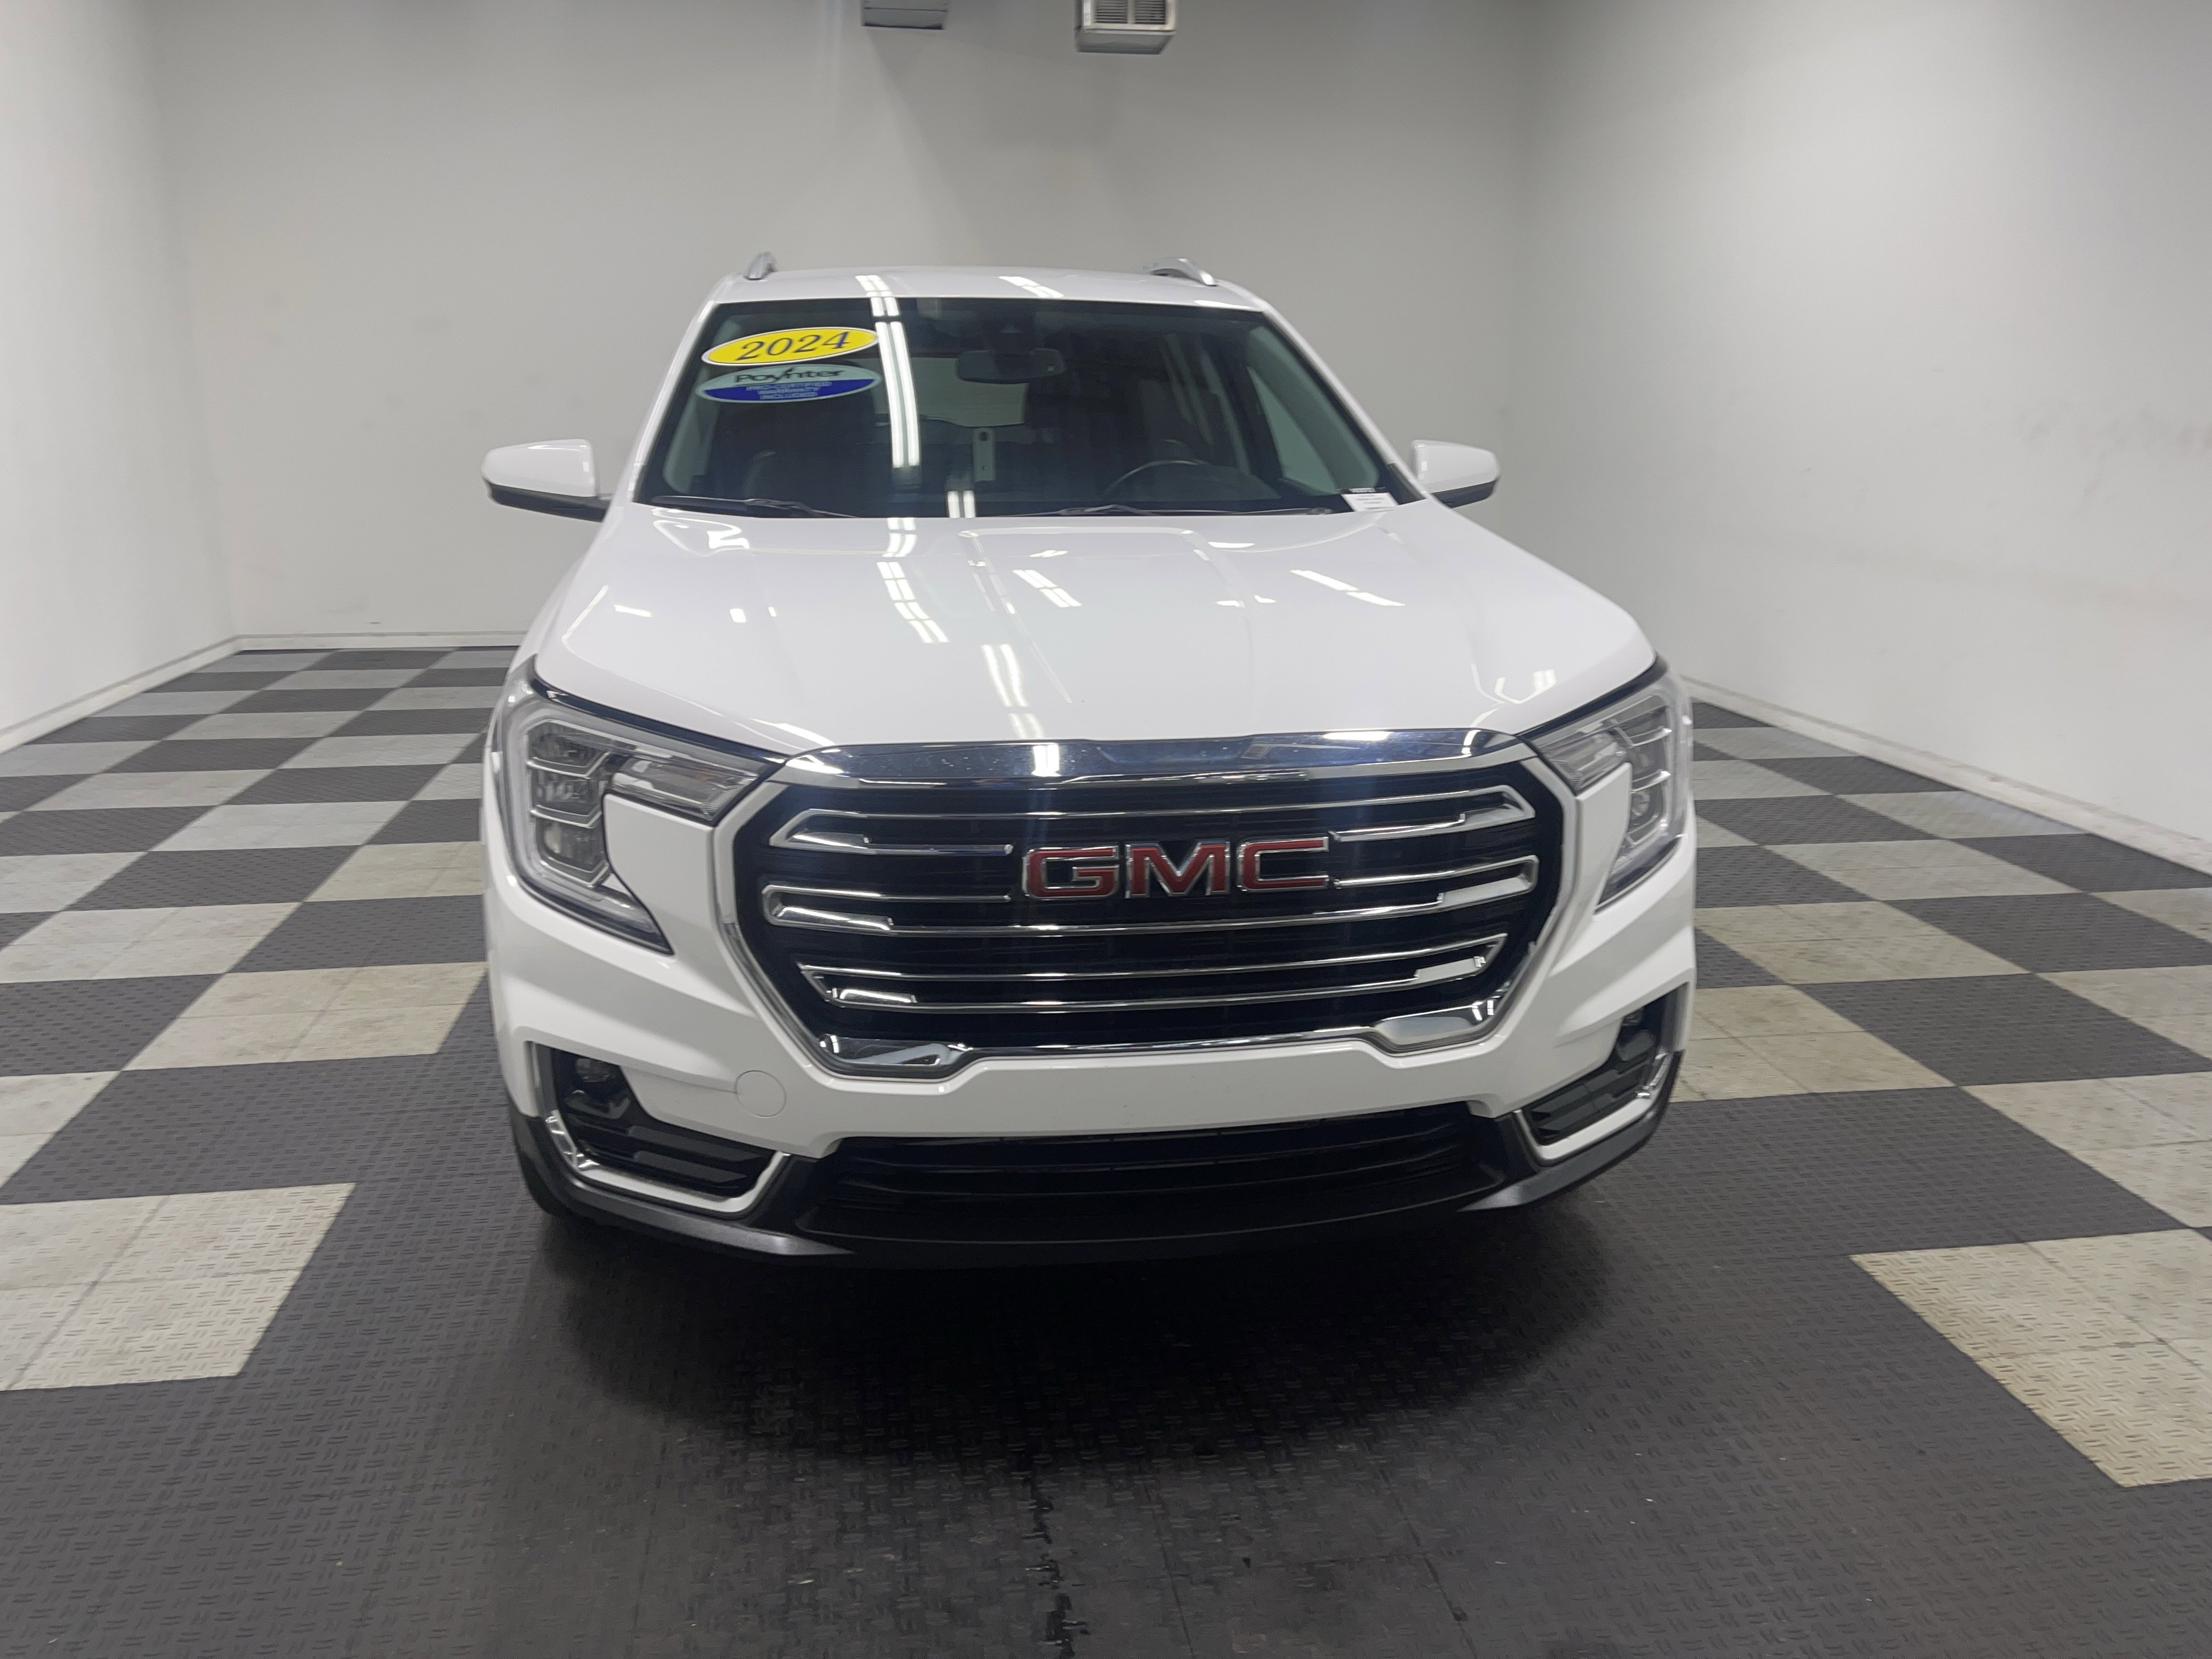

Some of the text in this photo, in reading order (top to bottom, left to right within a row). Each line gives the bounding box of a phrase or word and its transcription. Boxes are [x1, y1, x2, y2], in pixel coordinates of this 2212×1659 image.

[735, 331, 851, 360] 2024
[734, 368, 845, 385] Poynter
[1022, 836, 1329, 900] GMC
